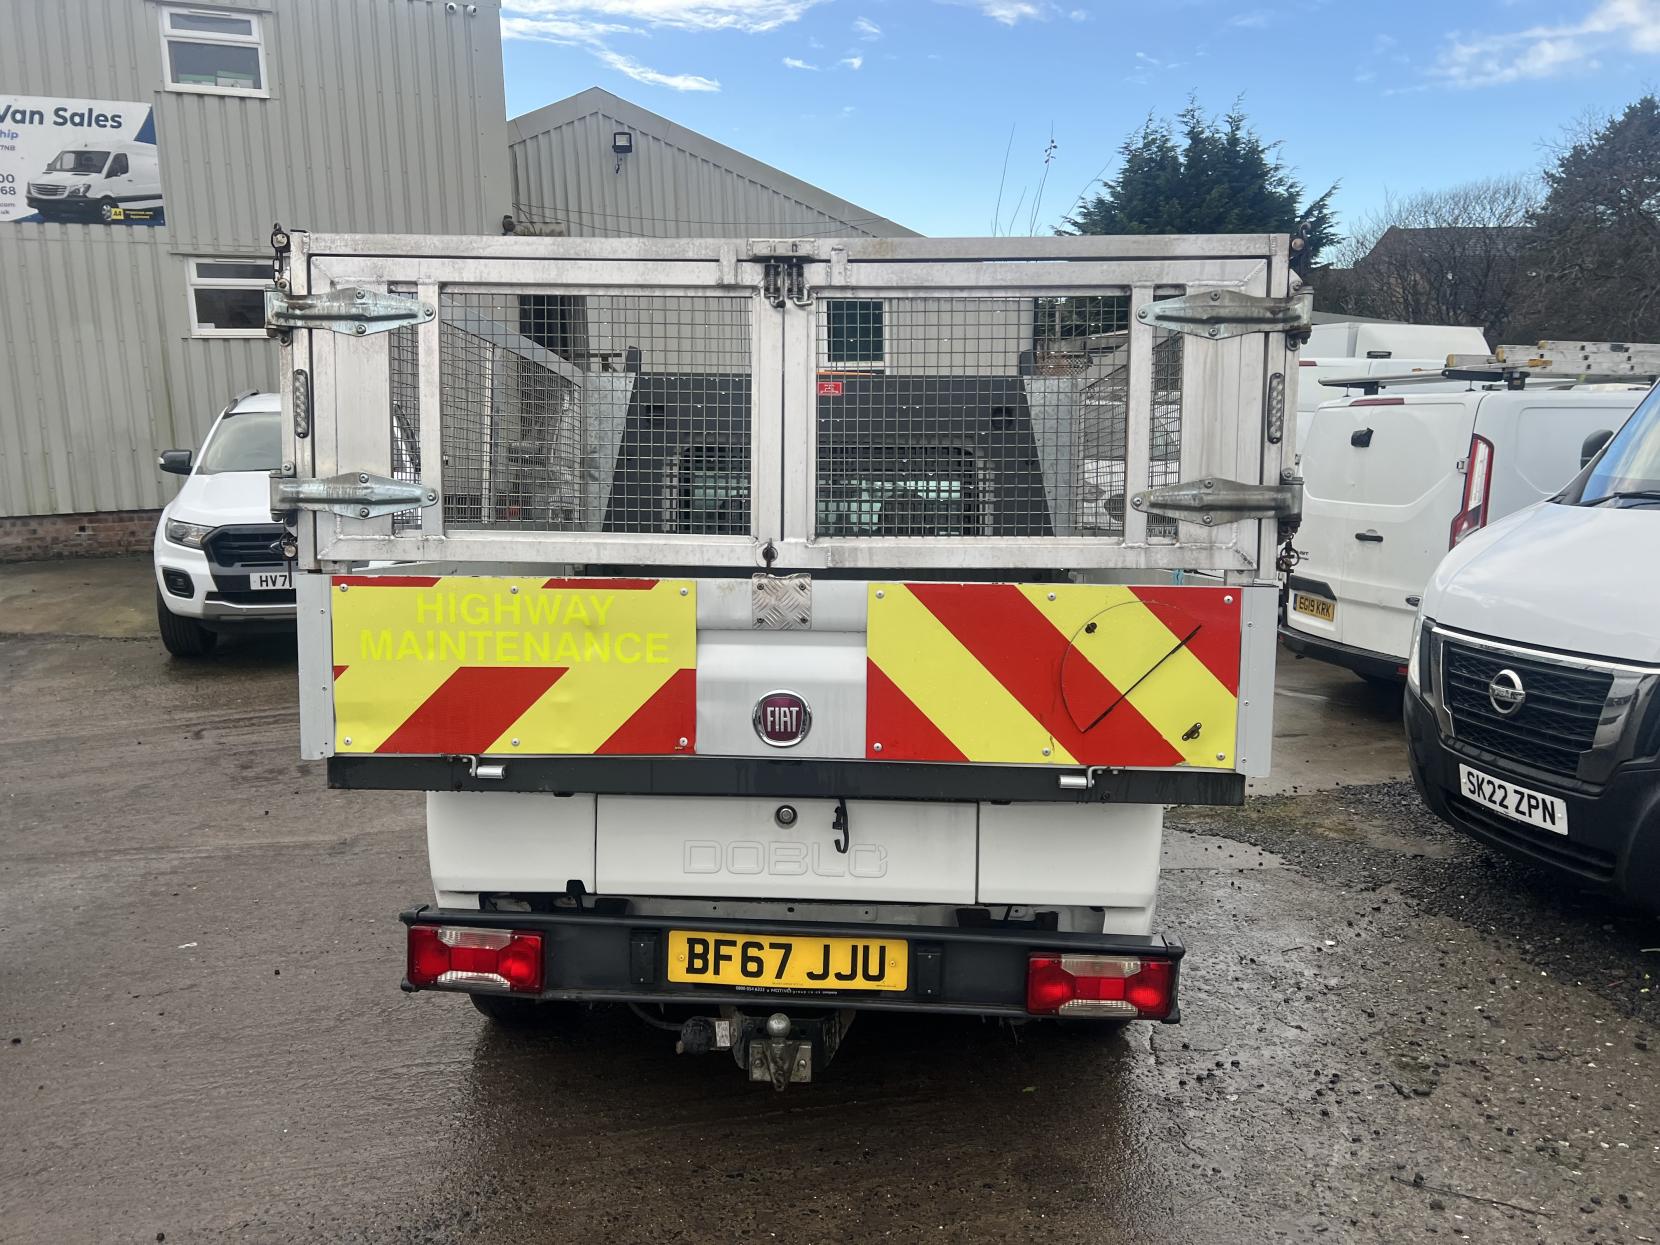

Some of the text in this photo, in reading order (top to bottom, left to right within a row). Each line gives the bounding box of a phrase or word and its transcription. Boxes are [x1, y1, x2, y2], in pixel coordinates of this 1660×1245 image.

[53, 107, 122, 129] Sales
[260, 574, 292, 588] HV7
[416, 592, 615, 626] HIGHWAY
[1299, 596, 1331, 618] EG19 KRK
[360, 629, 670, 664] MAINTENANCE
[766, 706, 800, 732] FIAT
[1466, 771, 1556, 826] SK22 ZPN
[685, 937, 886, 982] BF67 JJU
